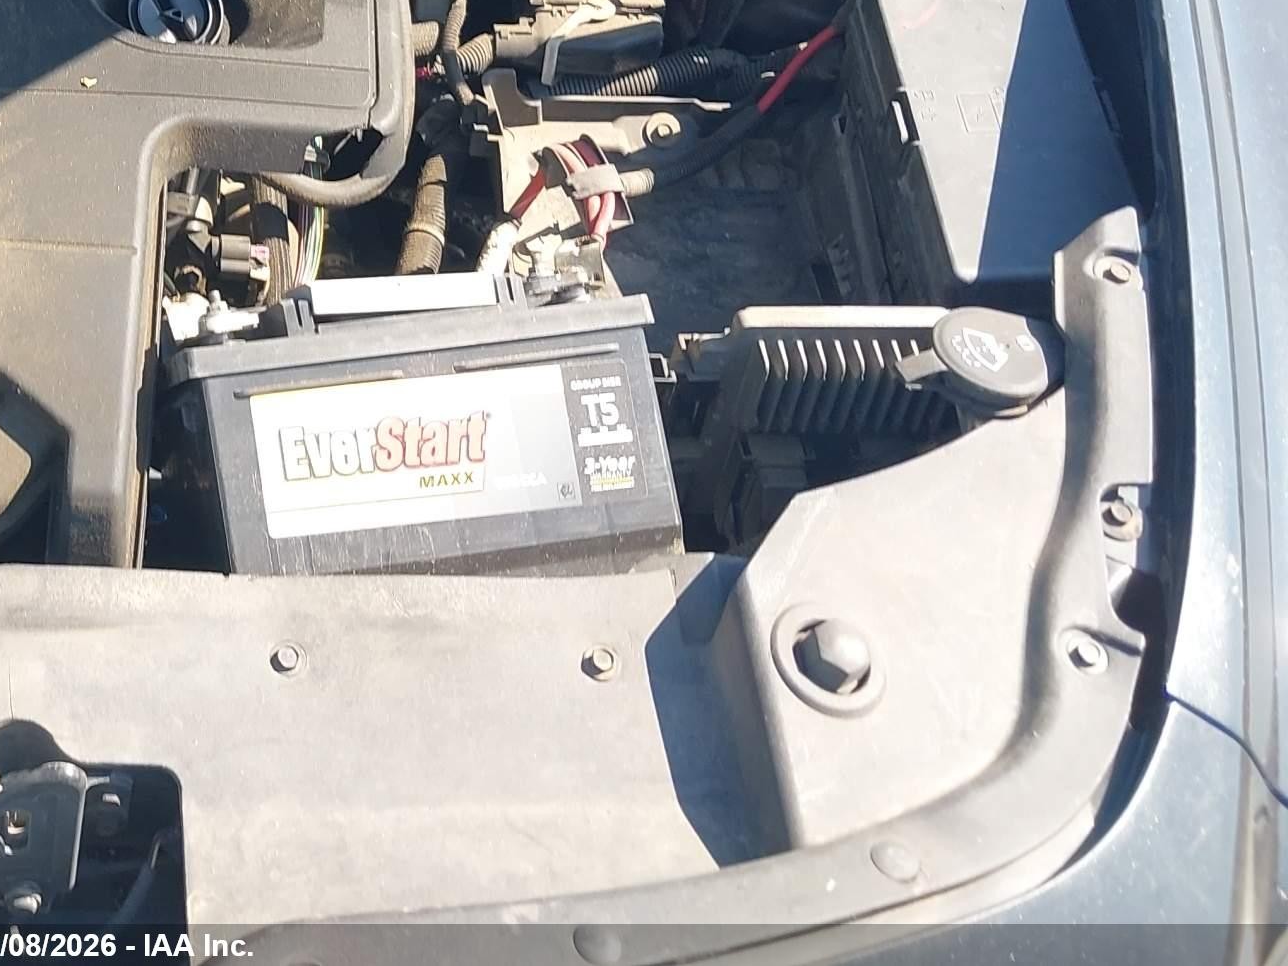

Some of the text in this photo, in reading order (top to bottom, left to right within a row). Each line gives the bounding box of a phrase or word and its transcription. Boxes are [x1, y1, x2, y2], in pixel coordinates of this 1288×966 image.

[580, 392, 620, 427] T5
[279, 410, 486, 481] EverStart
[419, 471, 474, 488] MAXX
